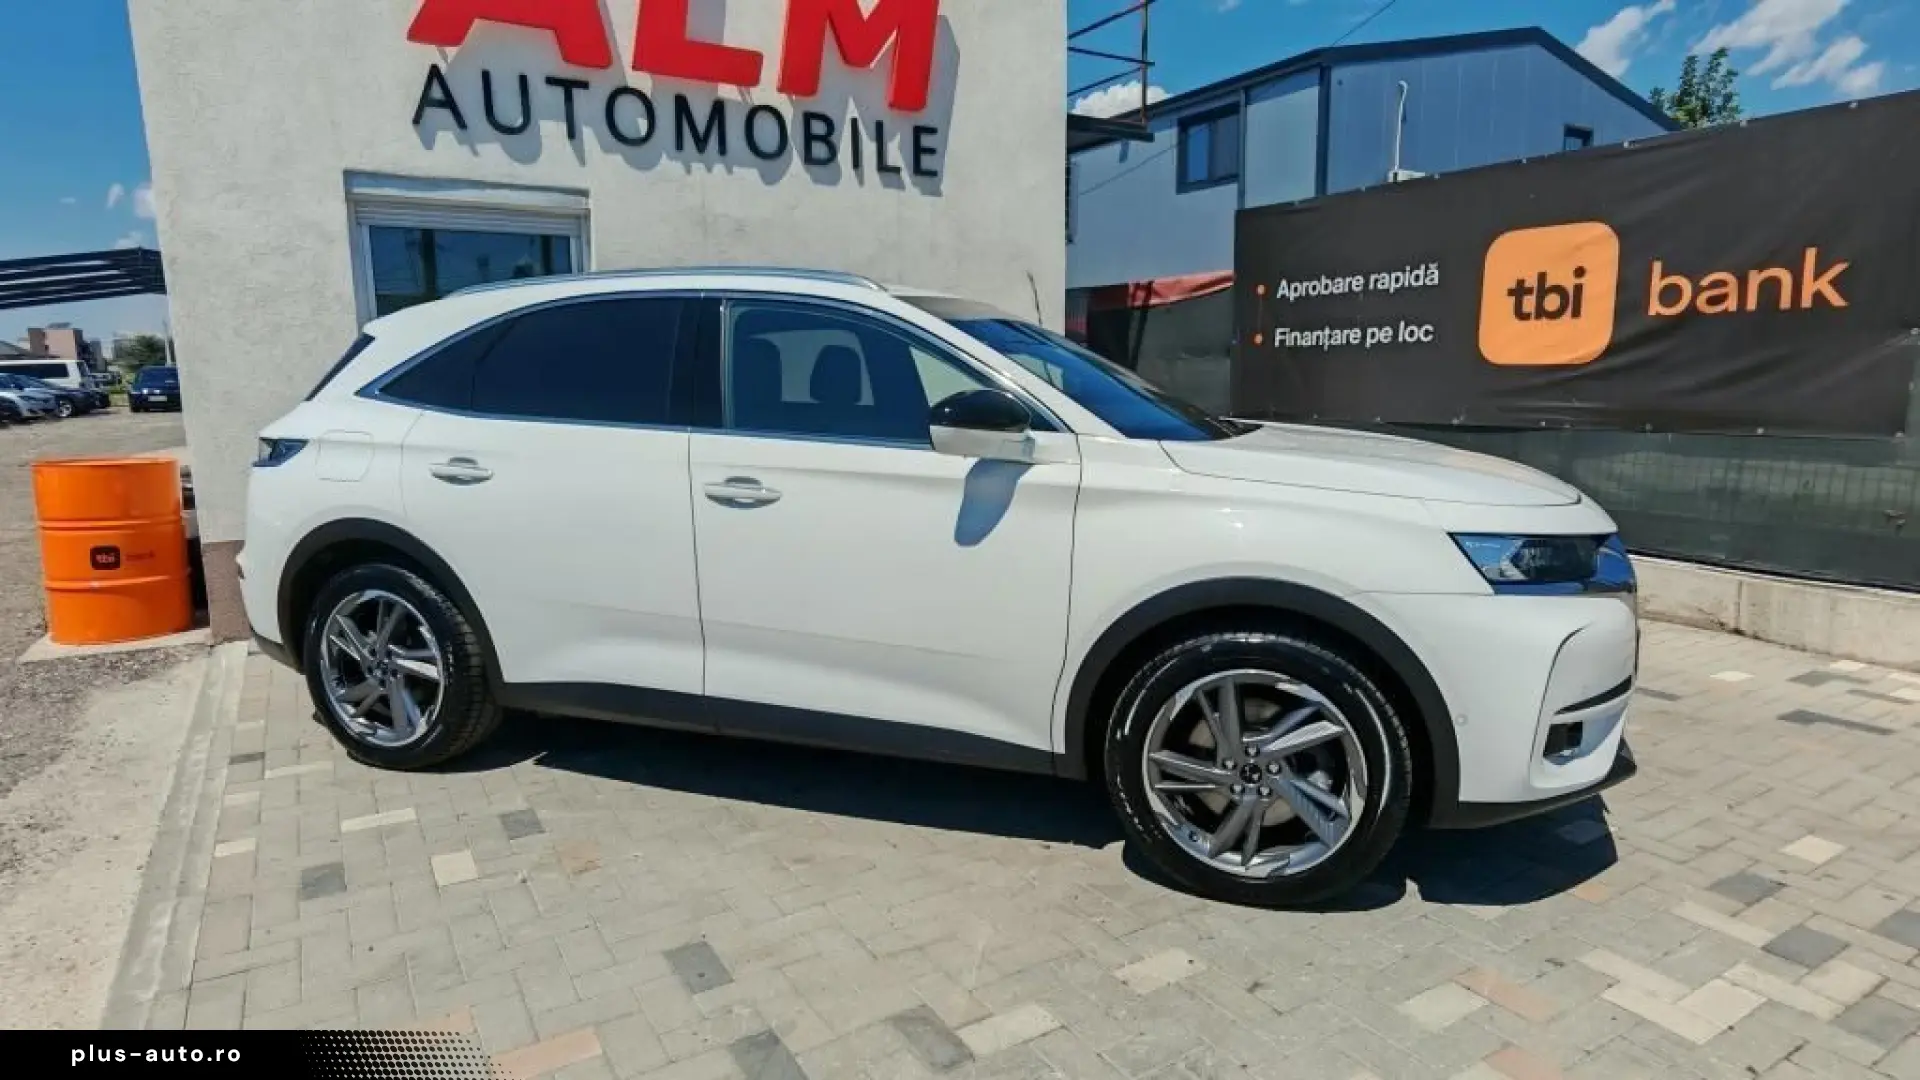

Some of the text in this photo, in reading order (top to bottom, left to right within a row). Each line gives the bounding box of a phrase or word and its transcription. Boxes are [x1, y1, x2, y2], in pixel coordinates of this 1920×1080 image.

[411, 63, 939, 178] AUTOMOBILE
[1276, 262, 1440, 302] Aprobare rapidă
[1507, 247, 1850, 322] tbi bank
[1274, 320, 1435, 351] Finanțare pe loc
